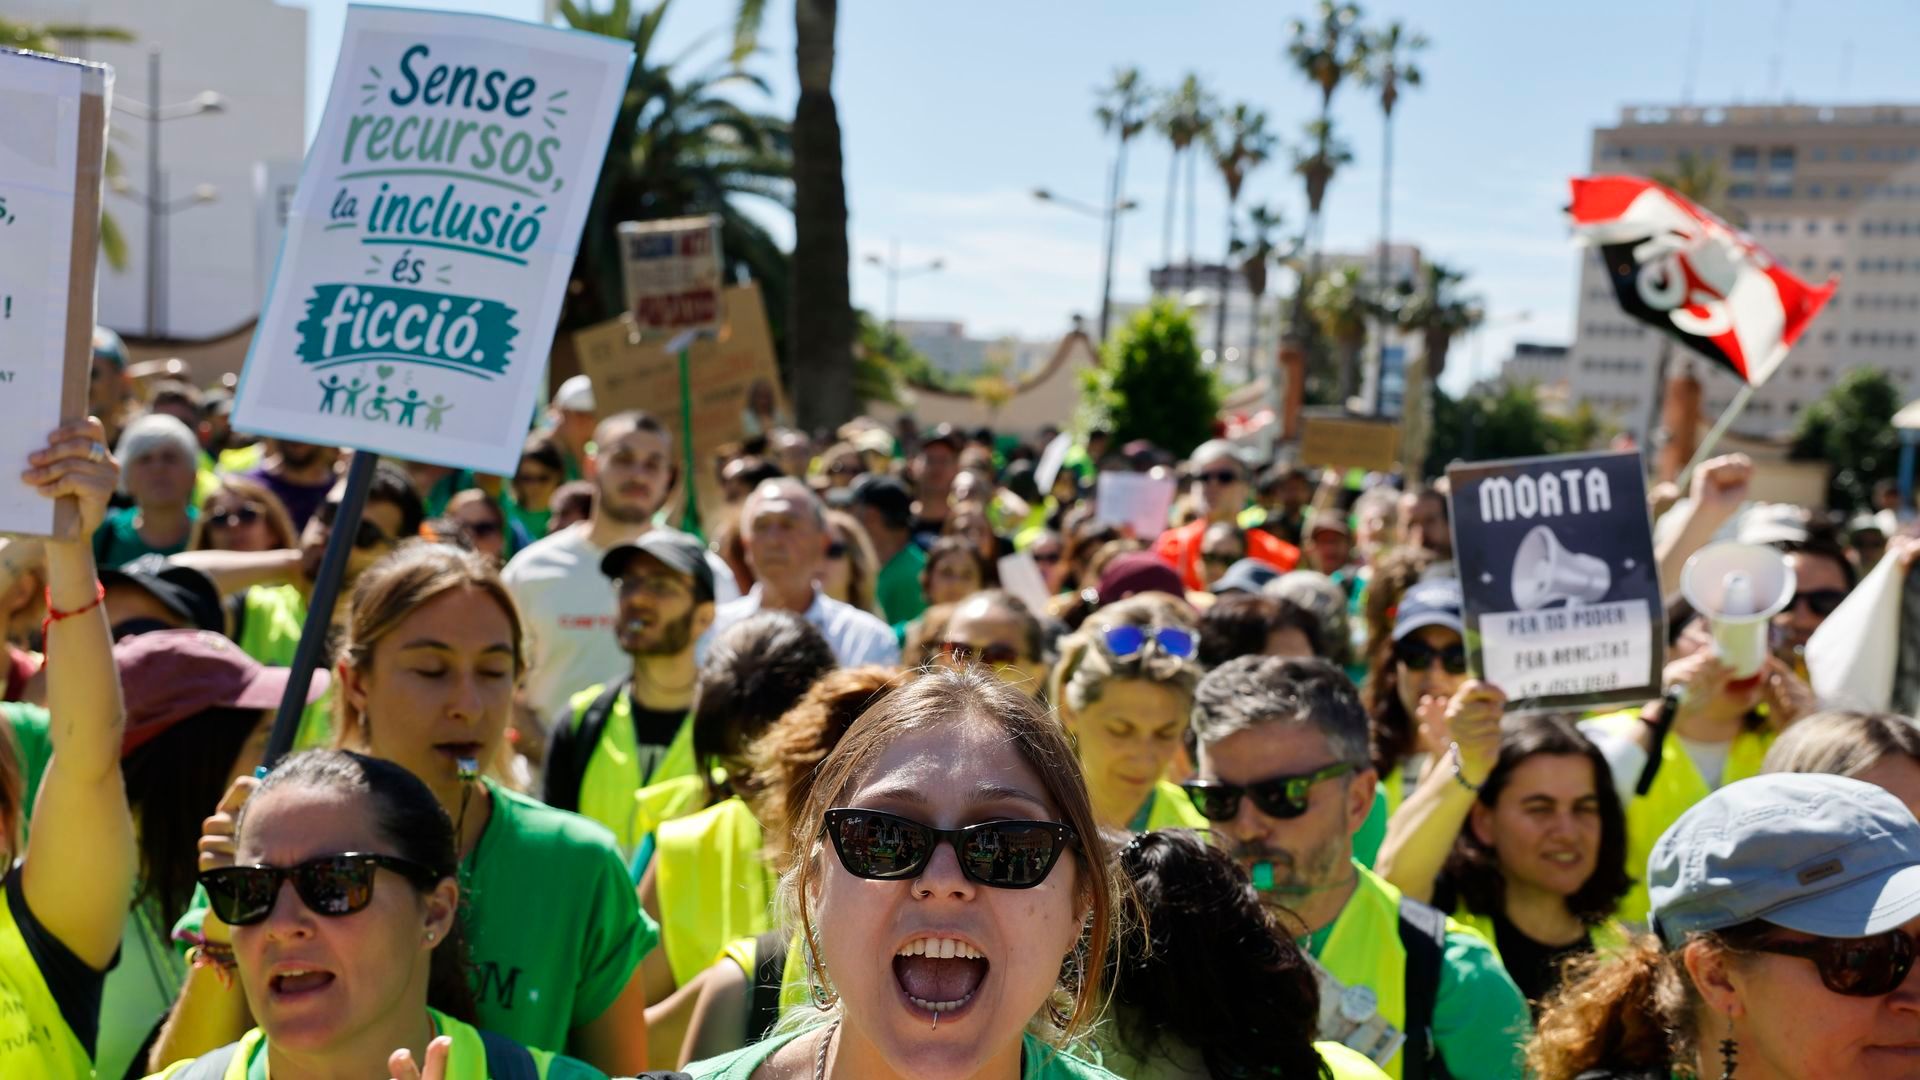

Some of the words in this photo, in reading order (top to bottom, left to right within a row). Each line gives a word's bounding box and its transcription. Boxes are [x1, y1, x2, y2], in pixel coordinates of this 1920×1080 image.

[390, 44, 536, 117] Sense
[341, 114, 563, 193] recursos,
[330, 187, 358, 219] la
[367, 183, 547, 253] inclusió
[392, 249, 425, 284] és
[322, 286, 484, 362] ficció.
[1478, 467, 1612, 523] MORTA
[1507, 616, 1539, 635] PER
[1545, 613, 1567, 631] NO
[1573, 607, 1627, 628] PODER
[1514, 650, 1547, 670] FER
